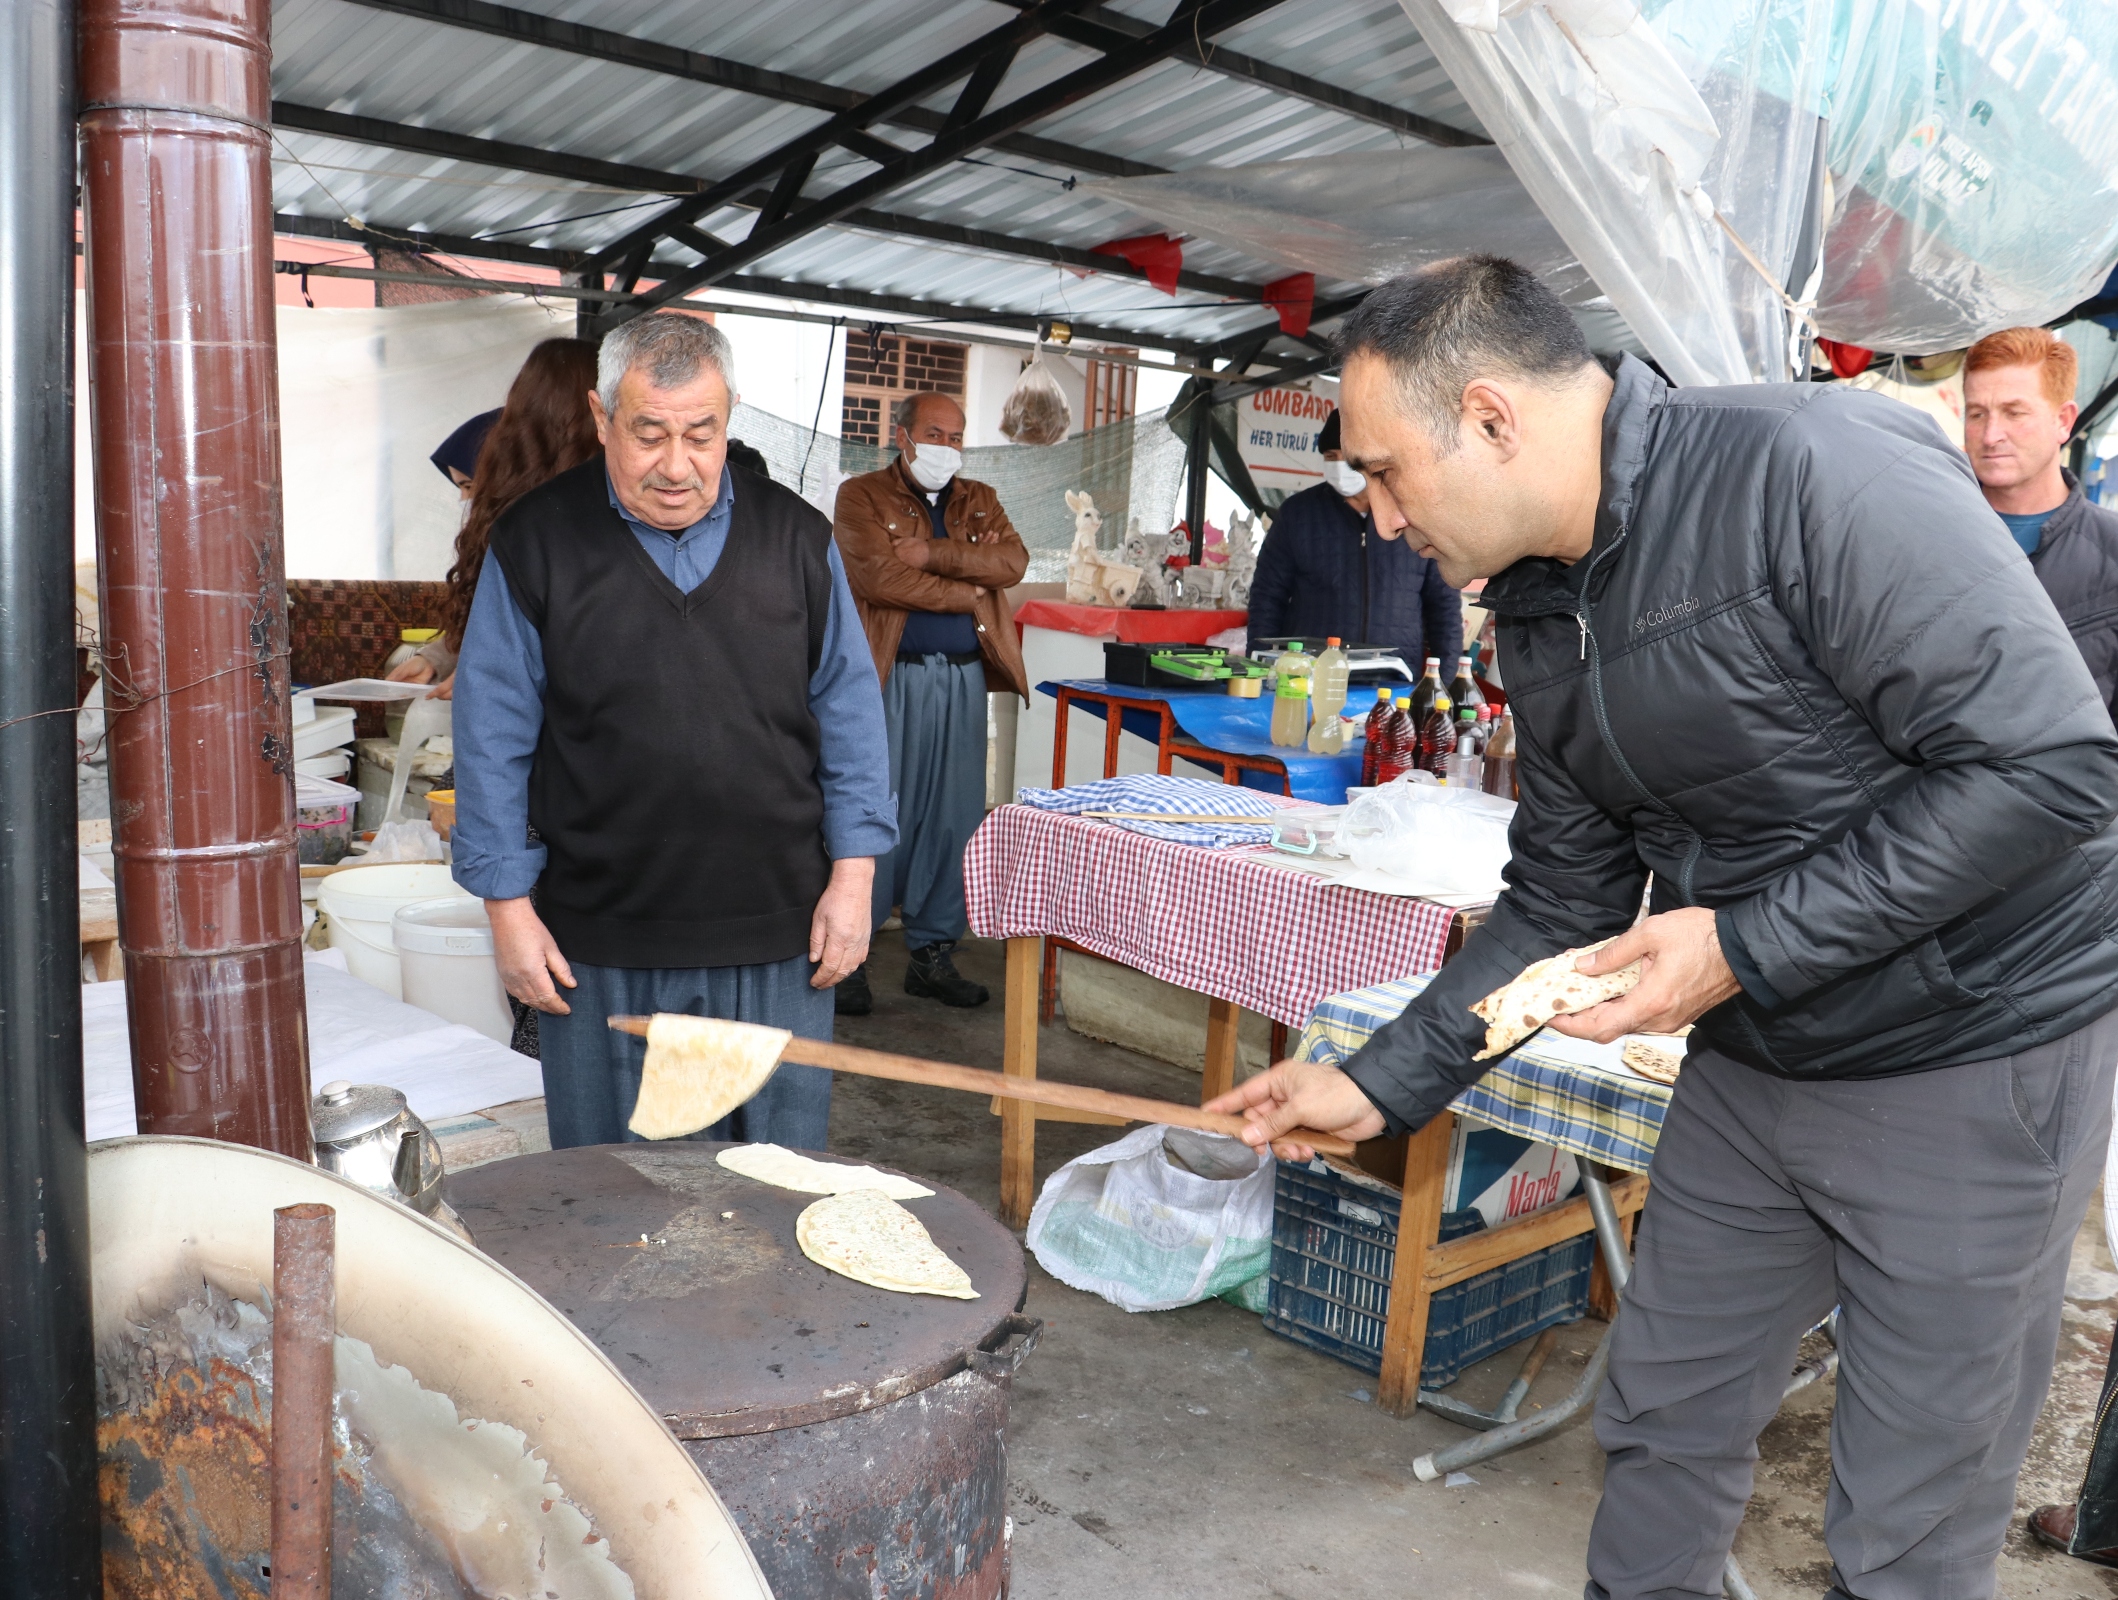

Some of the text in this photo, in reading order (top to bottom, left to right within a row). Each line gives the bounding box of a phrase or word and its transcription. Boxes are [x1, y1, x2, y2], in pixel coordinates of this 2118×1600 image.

[1250, 429, 1273, 449] HER
[1276, 429, 1309, 451] TÜRLÜ
[1646, 596, 1700, 627] Columbia
[1502, 1147, 1562, 1222] Marla
